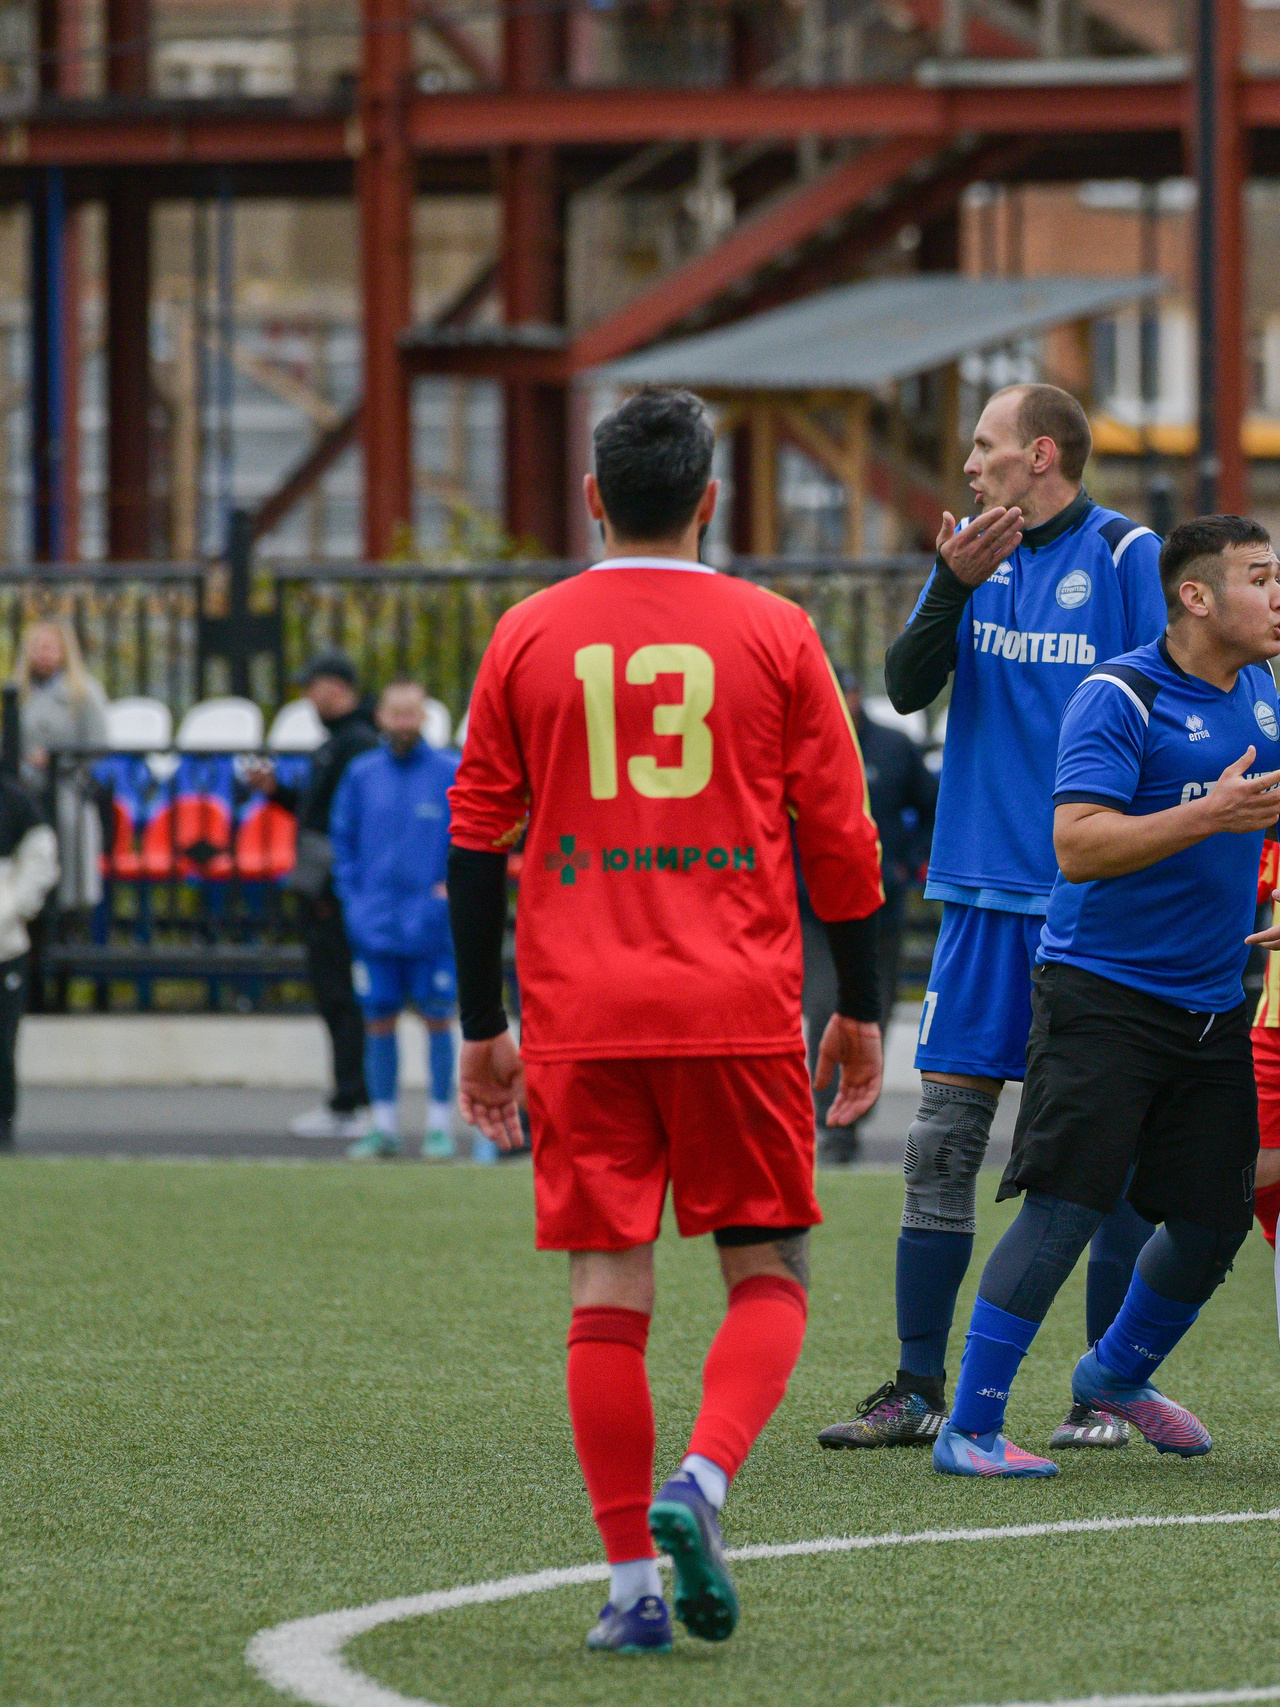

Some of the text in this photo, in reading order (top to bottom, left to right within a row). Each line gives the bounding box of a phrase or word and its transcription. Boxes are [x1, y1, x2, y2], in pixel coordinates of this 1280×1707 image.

[574, 643, 715, 800] 13
[1188, 729, 1211, 742] errea
[602, 846, 756, 873] ЮНИРОН
